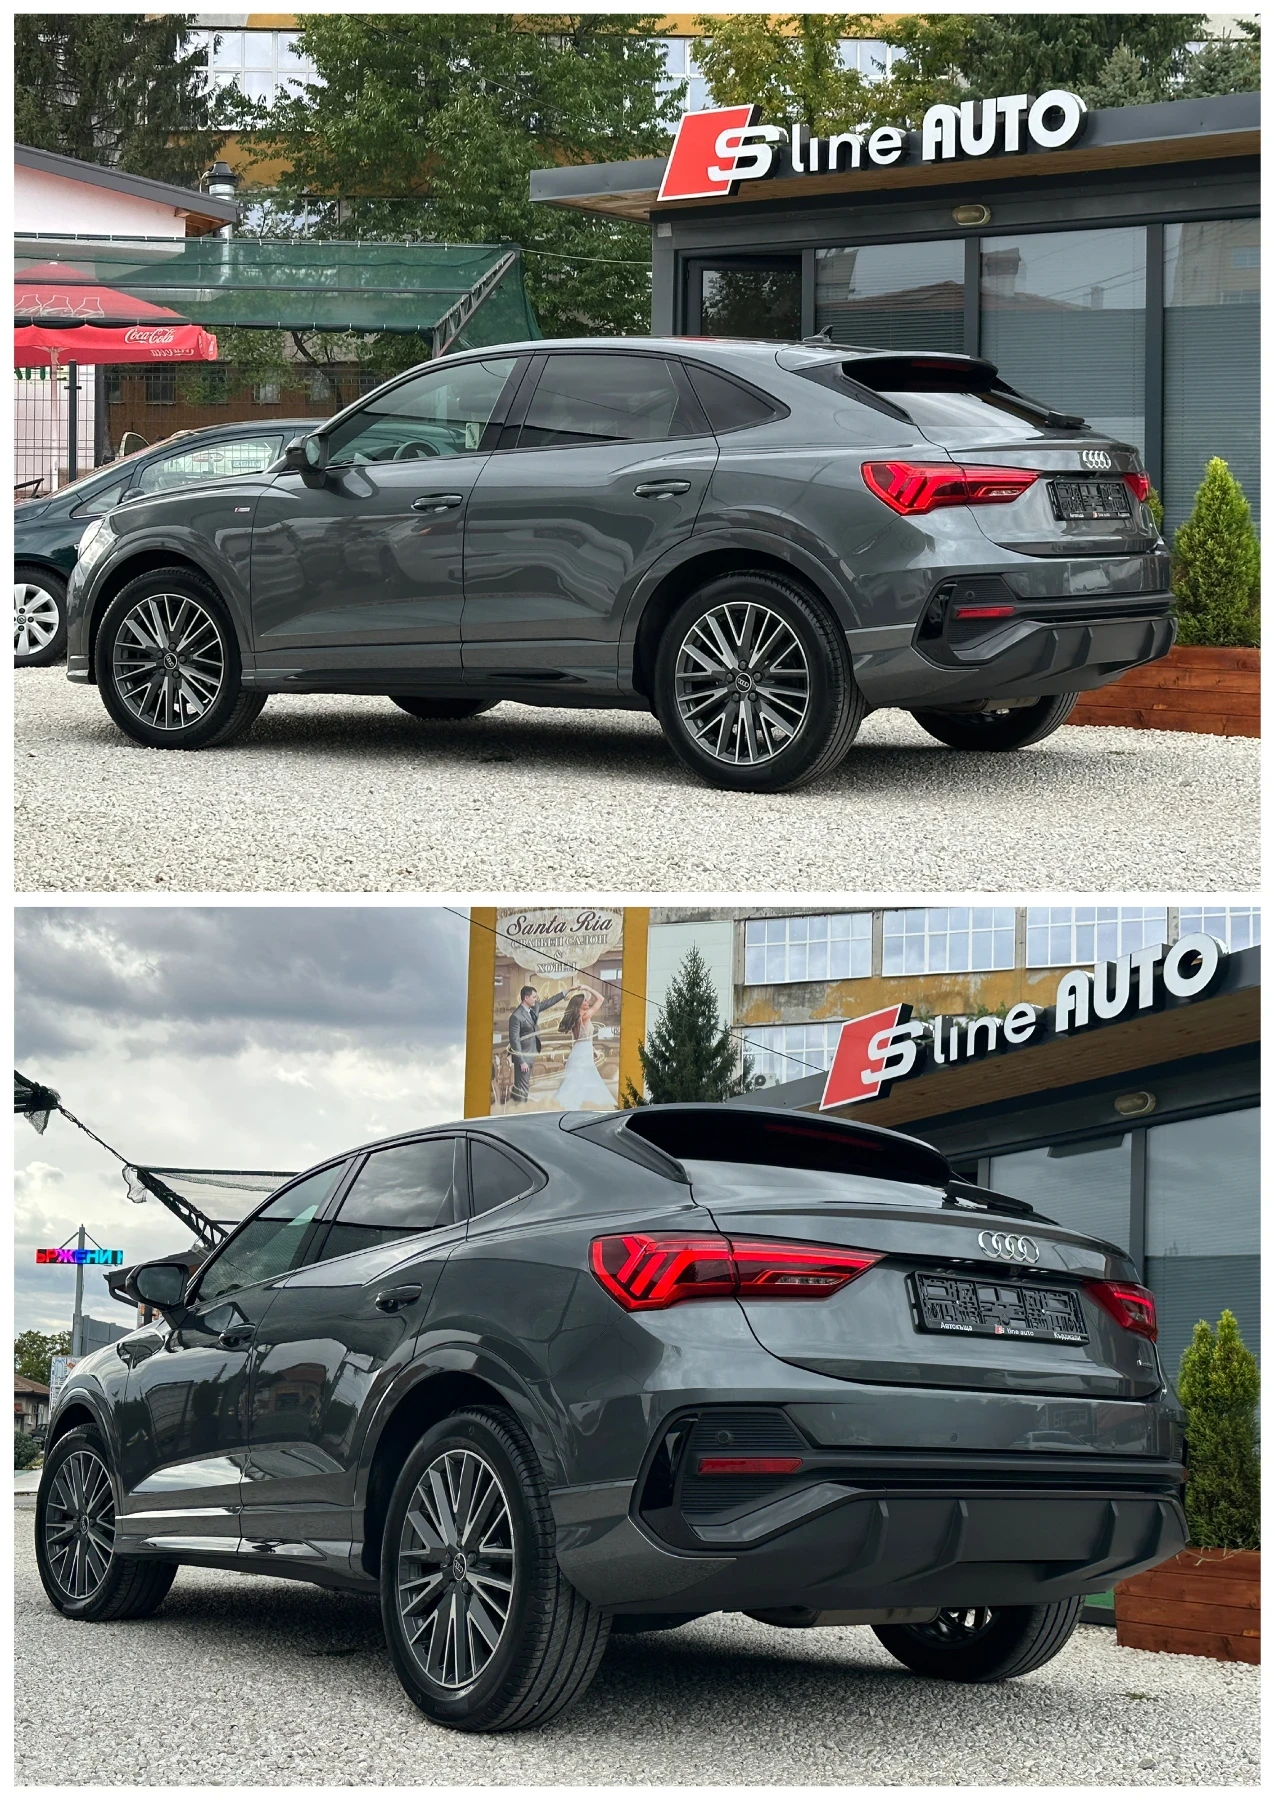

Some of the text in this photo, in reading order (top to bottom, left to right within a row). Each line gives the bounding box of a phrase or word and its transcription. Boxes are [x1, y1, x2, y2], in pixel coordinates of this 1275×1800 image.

[707, 90, 1082, 181] S line AUTO
[125, 328, 177, 344] Coca-Cola
[506, 911, 612, 936] Santa Ria
[861, 932, 1220, 1085] S line AUTO
